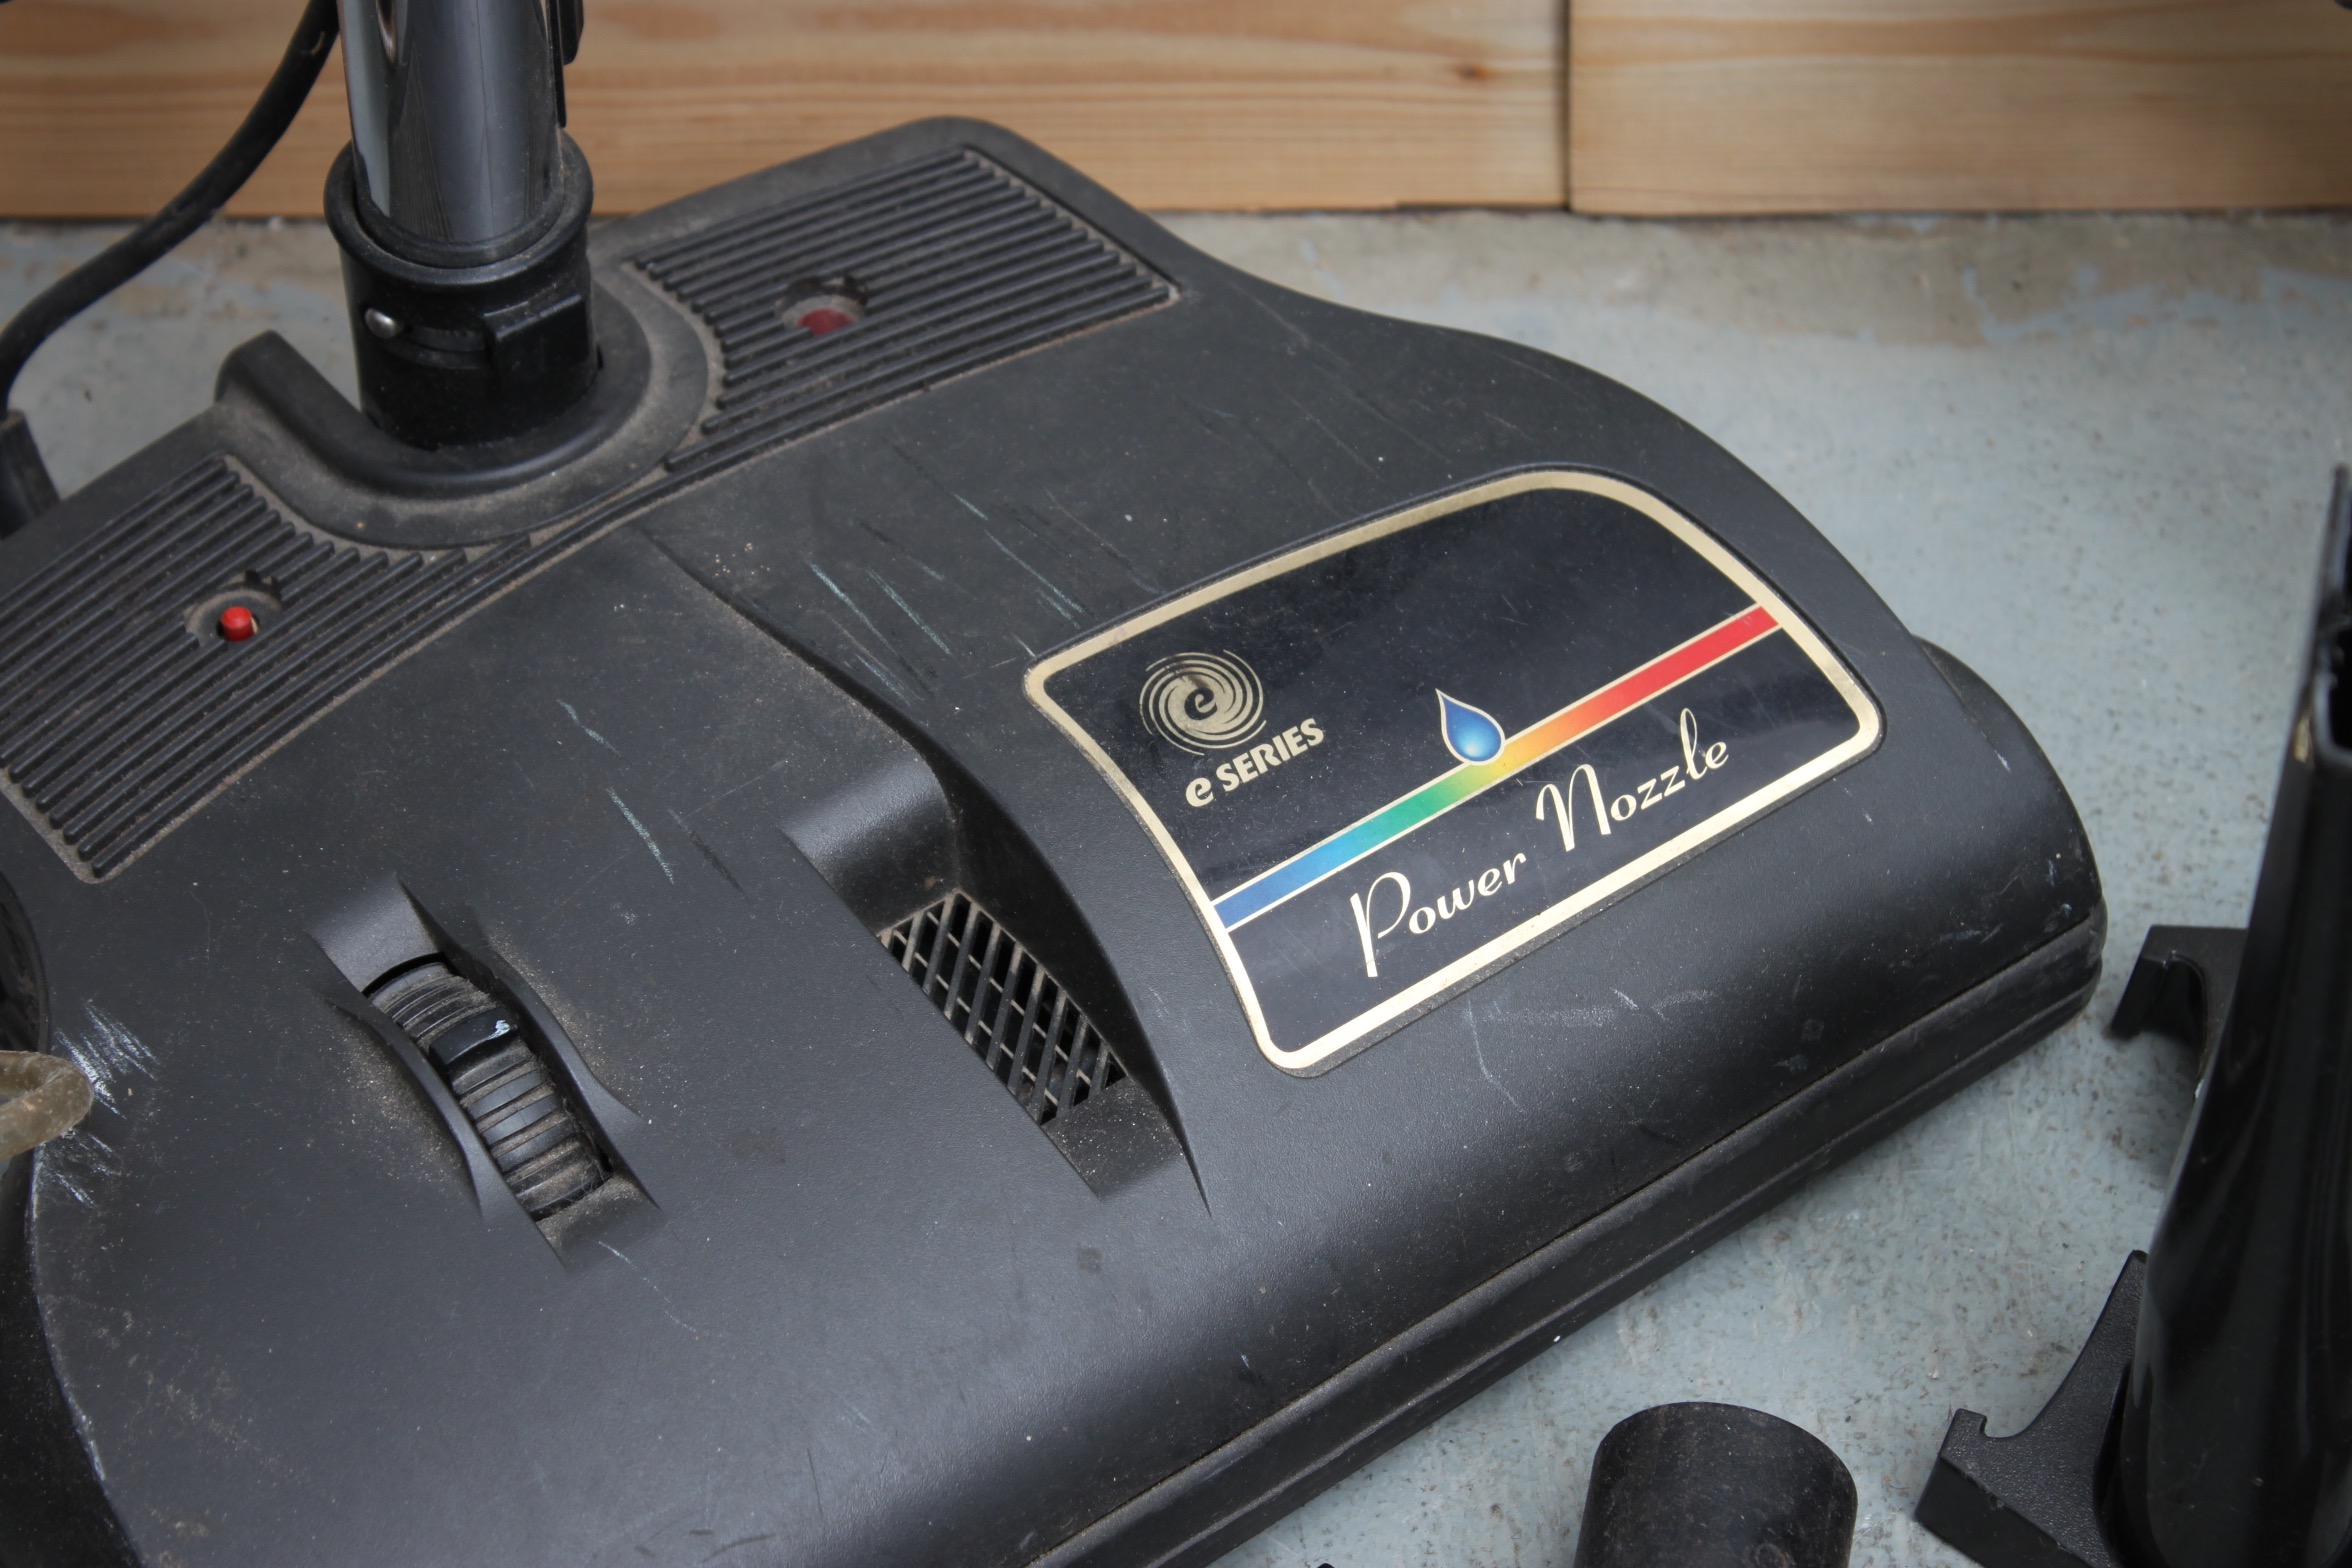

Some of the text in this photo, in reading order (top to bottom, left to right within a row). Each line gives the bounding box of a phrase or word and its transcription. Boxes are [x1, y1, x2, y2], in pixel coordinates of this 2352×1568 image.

[1186, 718, 1324, 807] e SERIES
[1350, 708, 1729, 977] Power Nozzle
